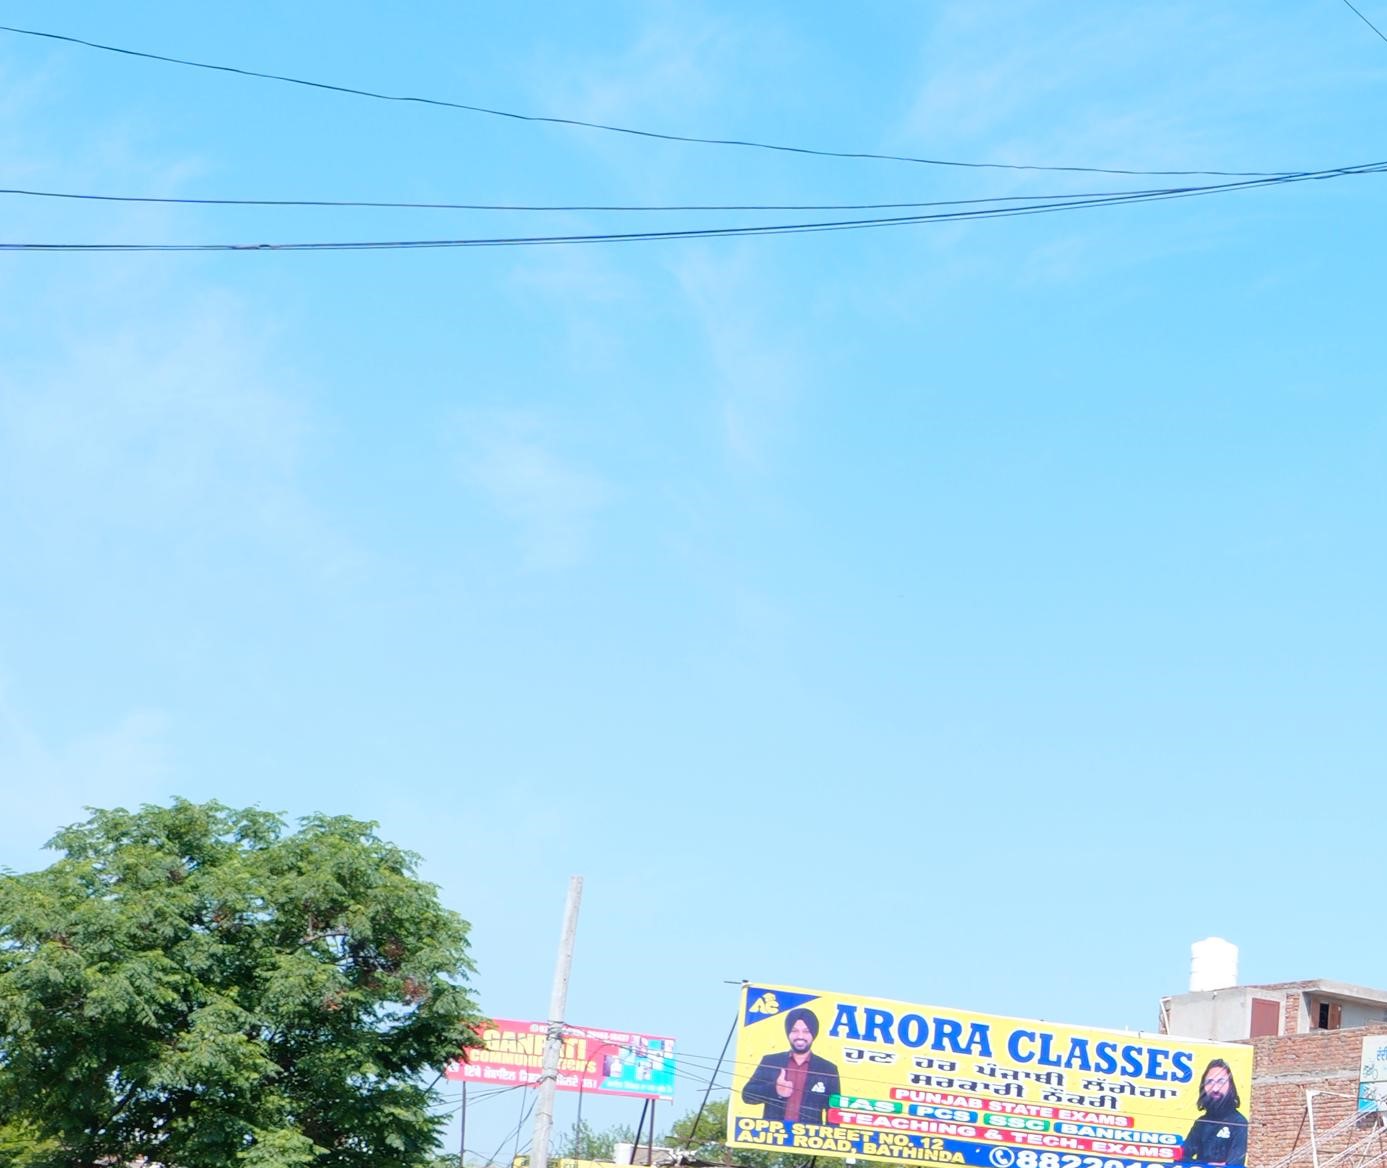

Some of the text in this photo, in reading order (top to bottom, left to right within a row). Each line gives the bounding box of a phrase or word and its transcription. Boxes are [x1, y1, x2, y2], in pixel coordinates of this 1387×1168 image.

[483, 1029, 587, 1060] GANPTI
[829, 1003, 1193, 1083] ARORA CLASSES
[910, 1072, 1024, 1098] ਸਰਕਾਰੀ
[914, 1056, 957, 1072] ਹਰ
[974, 1060, 1065, 1087] ਪੰਜਾਬੀ
[840, 1097, 1177, 1145] IAS PCS SSC BANKING
[895, 1089, 1128, 1127] PUNJAB STATE EXAMS
[738, 1119, 944, 1150] OPP. STREET NO. 12
[738, 1131, 966, 1164] AJIT ROAD, BATHINDA
[838, 1112, 1174, 1159] TEACHING & TECH. EXAMS
